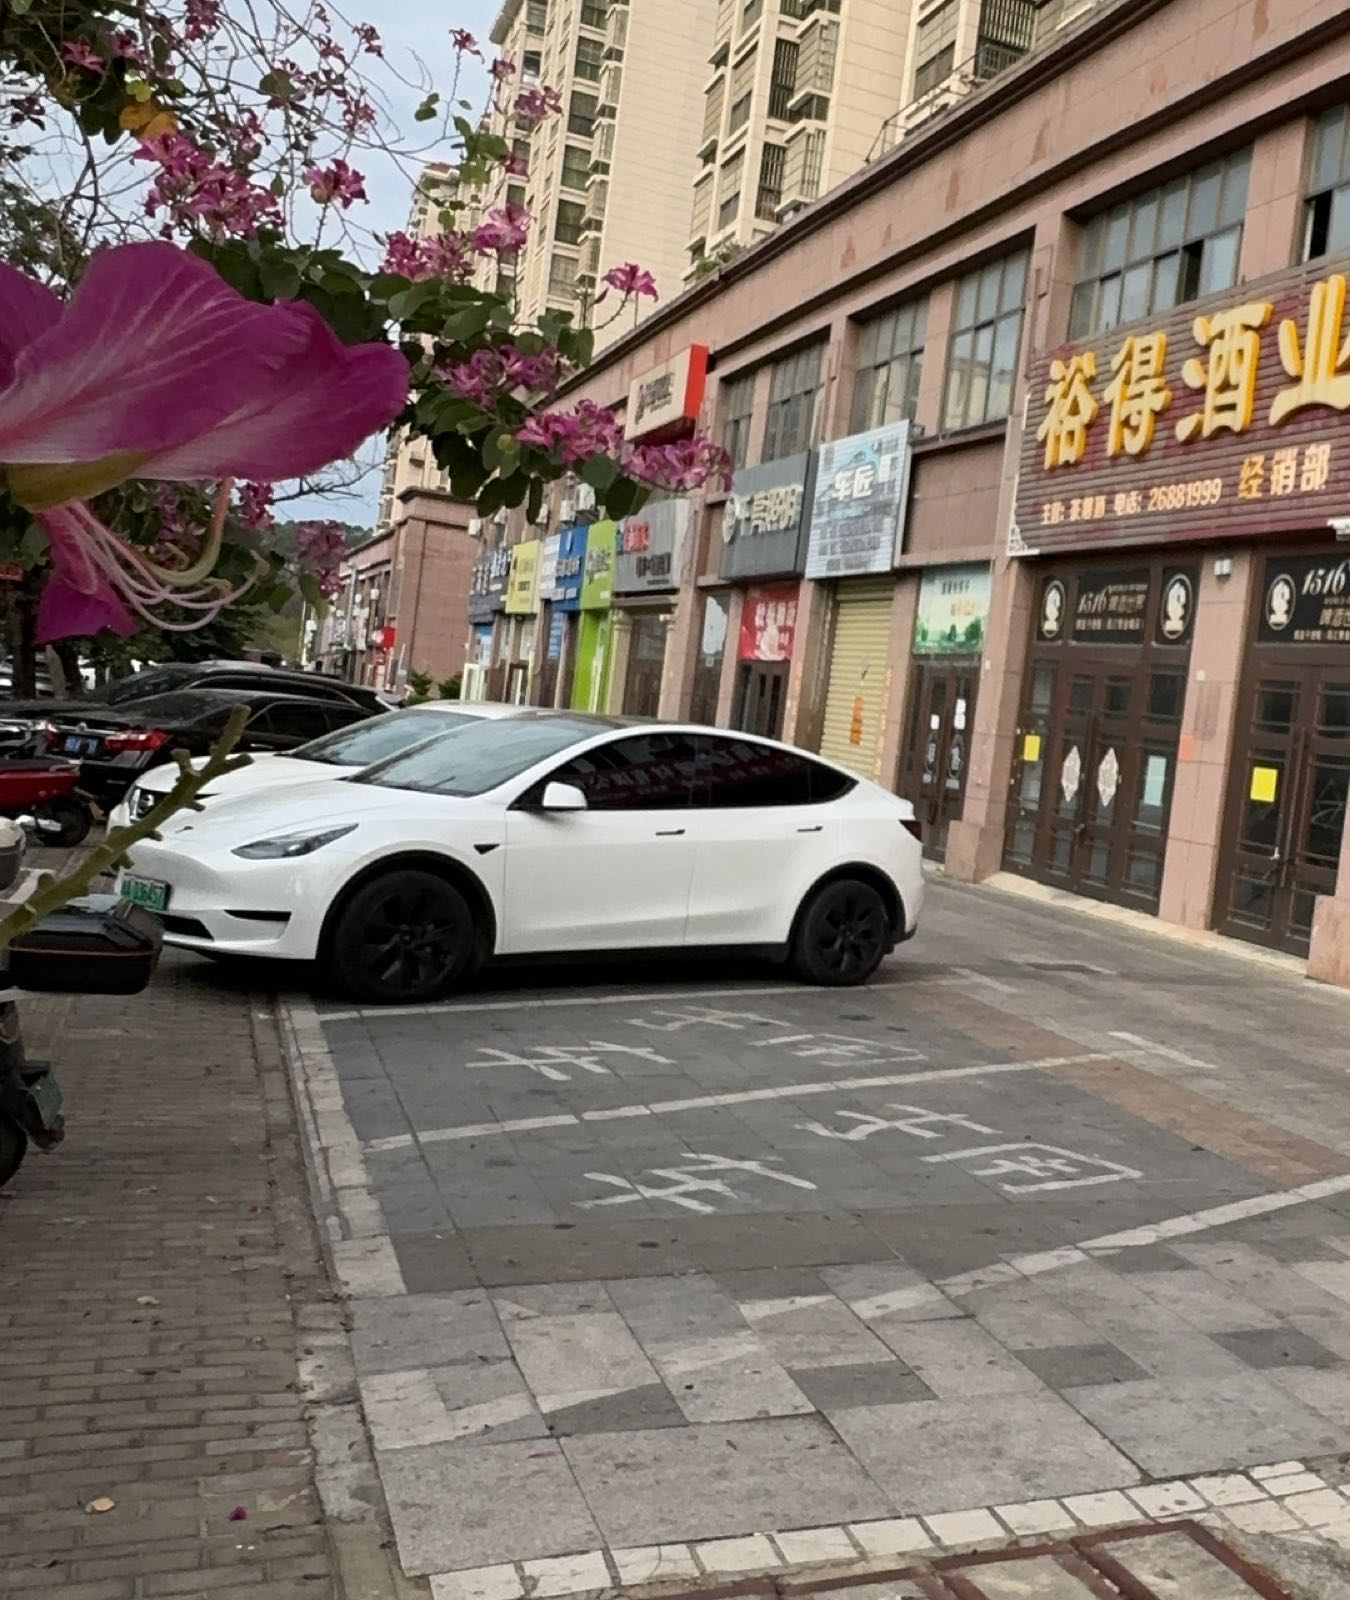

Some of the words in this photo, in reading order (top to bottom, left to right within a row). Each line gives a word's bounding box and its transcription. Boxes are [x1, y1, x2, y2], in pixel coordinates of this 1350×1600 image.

[1237, 443, 1332, 500] 经销部
[1147, 478, 1223, 512] 26881999
